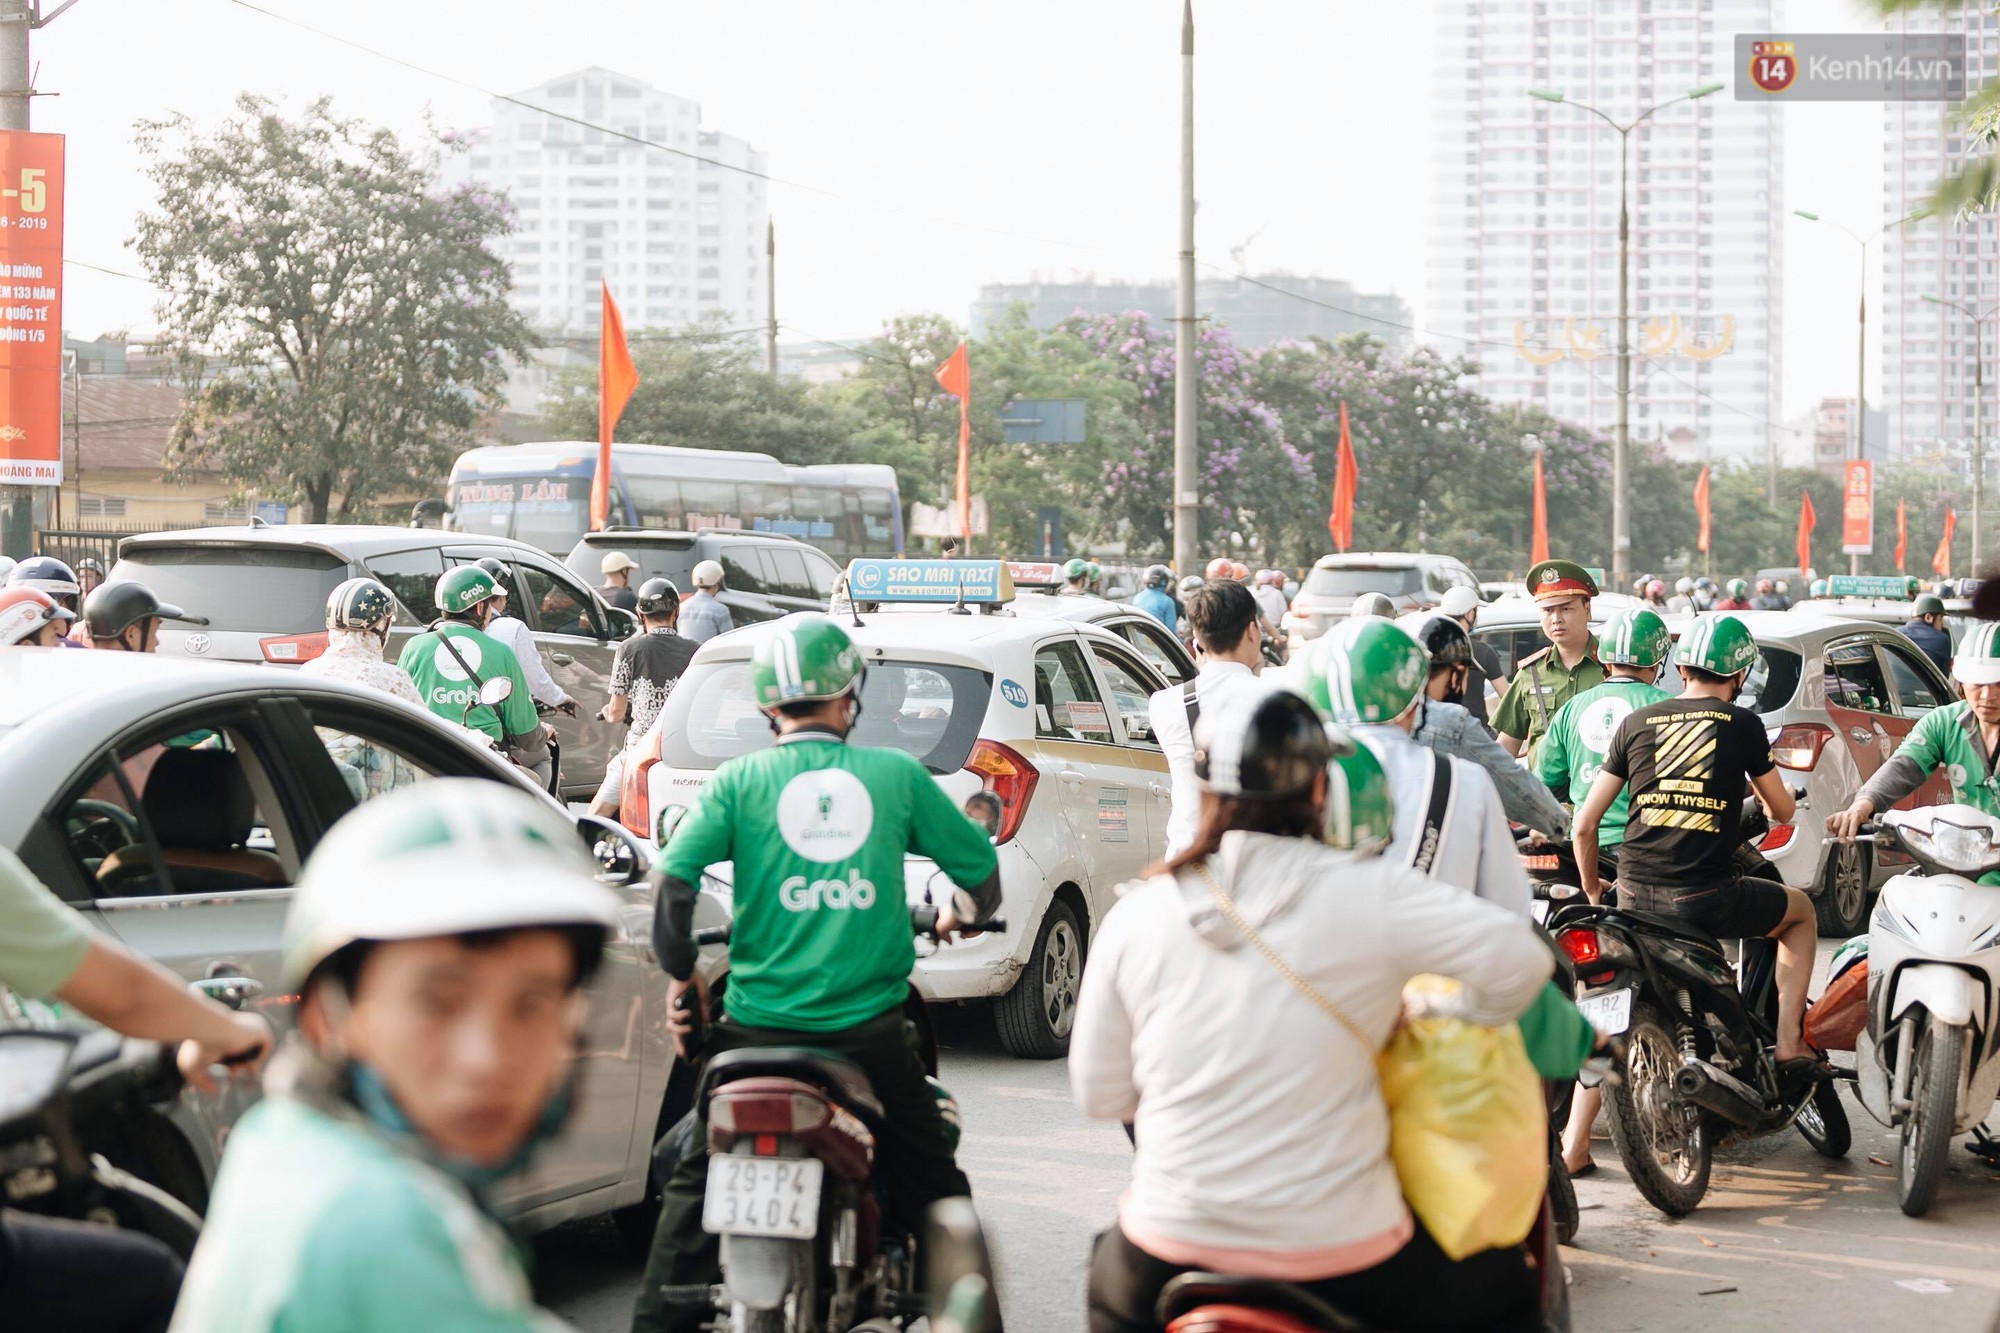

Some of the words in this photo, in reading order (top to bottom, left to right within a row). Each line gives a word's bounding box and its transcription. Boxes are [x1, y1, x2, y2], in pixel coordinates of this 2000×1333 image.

[0, 216, 8, 228] 6
[19, 217, 47, 229] 2019
[13, 286, 31, 299] 133
[33, 285, 55, 300] NĂM
[6, 304, 33, 321] QUỐC
[35, 305, 48, 321] TẾ
[28, 328, 45, 342] 1/5
[35, 466, 55, 478] MAI
[887, 566, 921, 583] SAO
[924, 567, 955, 583] MAI
[460, 583, 485, 600] Grab
[892, 587, 988, 596] www.saomaita.com
[433, 685, 480, 705] Grab
[1002, 684, 1027, 704] 519
[1646, 716, 1671, 725] KEEN
[1671, 714, 1684, 722] ON
[1685, 710, 1732, 722] CREATION
[1636, 793, 1671, 805] KNOW
[1672, 794, 1728, 811] THYSELF
[779, 868, 877, 912] Grab
[726, 1161, 805, 1194] 29-P4
[723, 1197, 800, 1228] 3404
